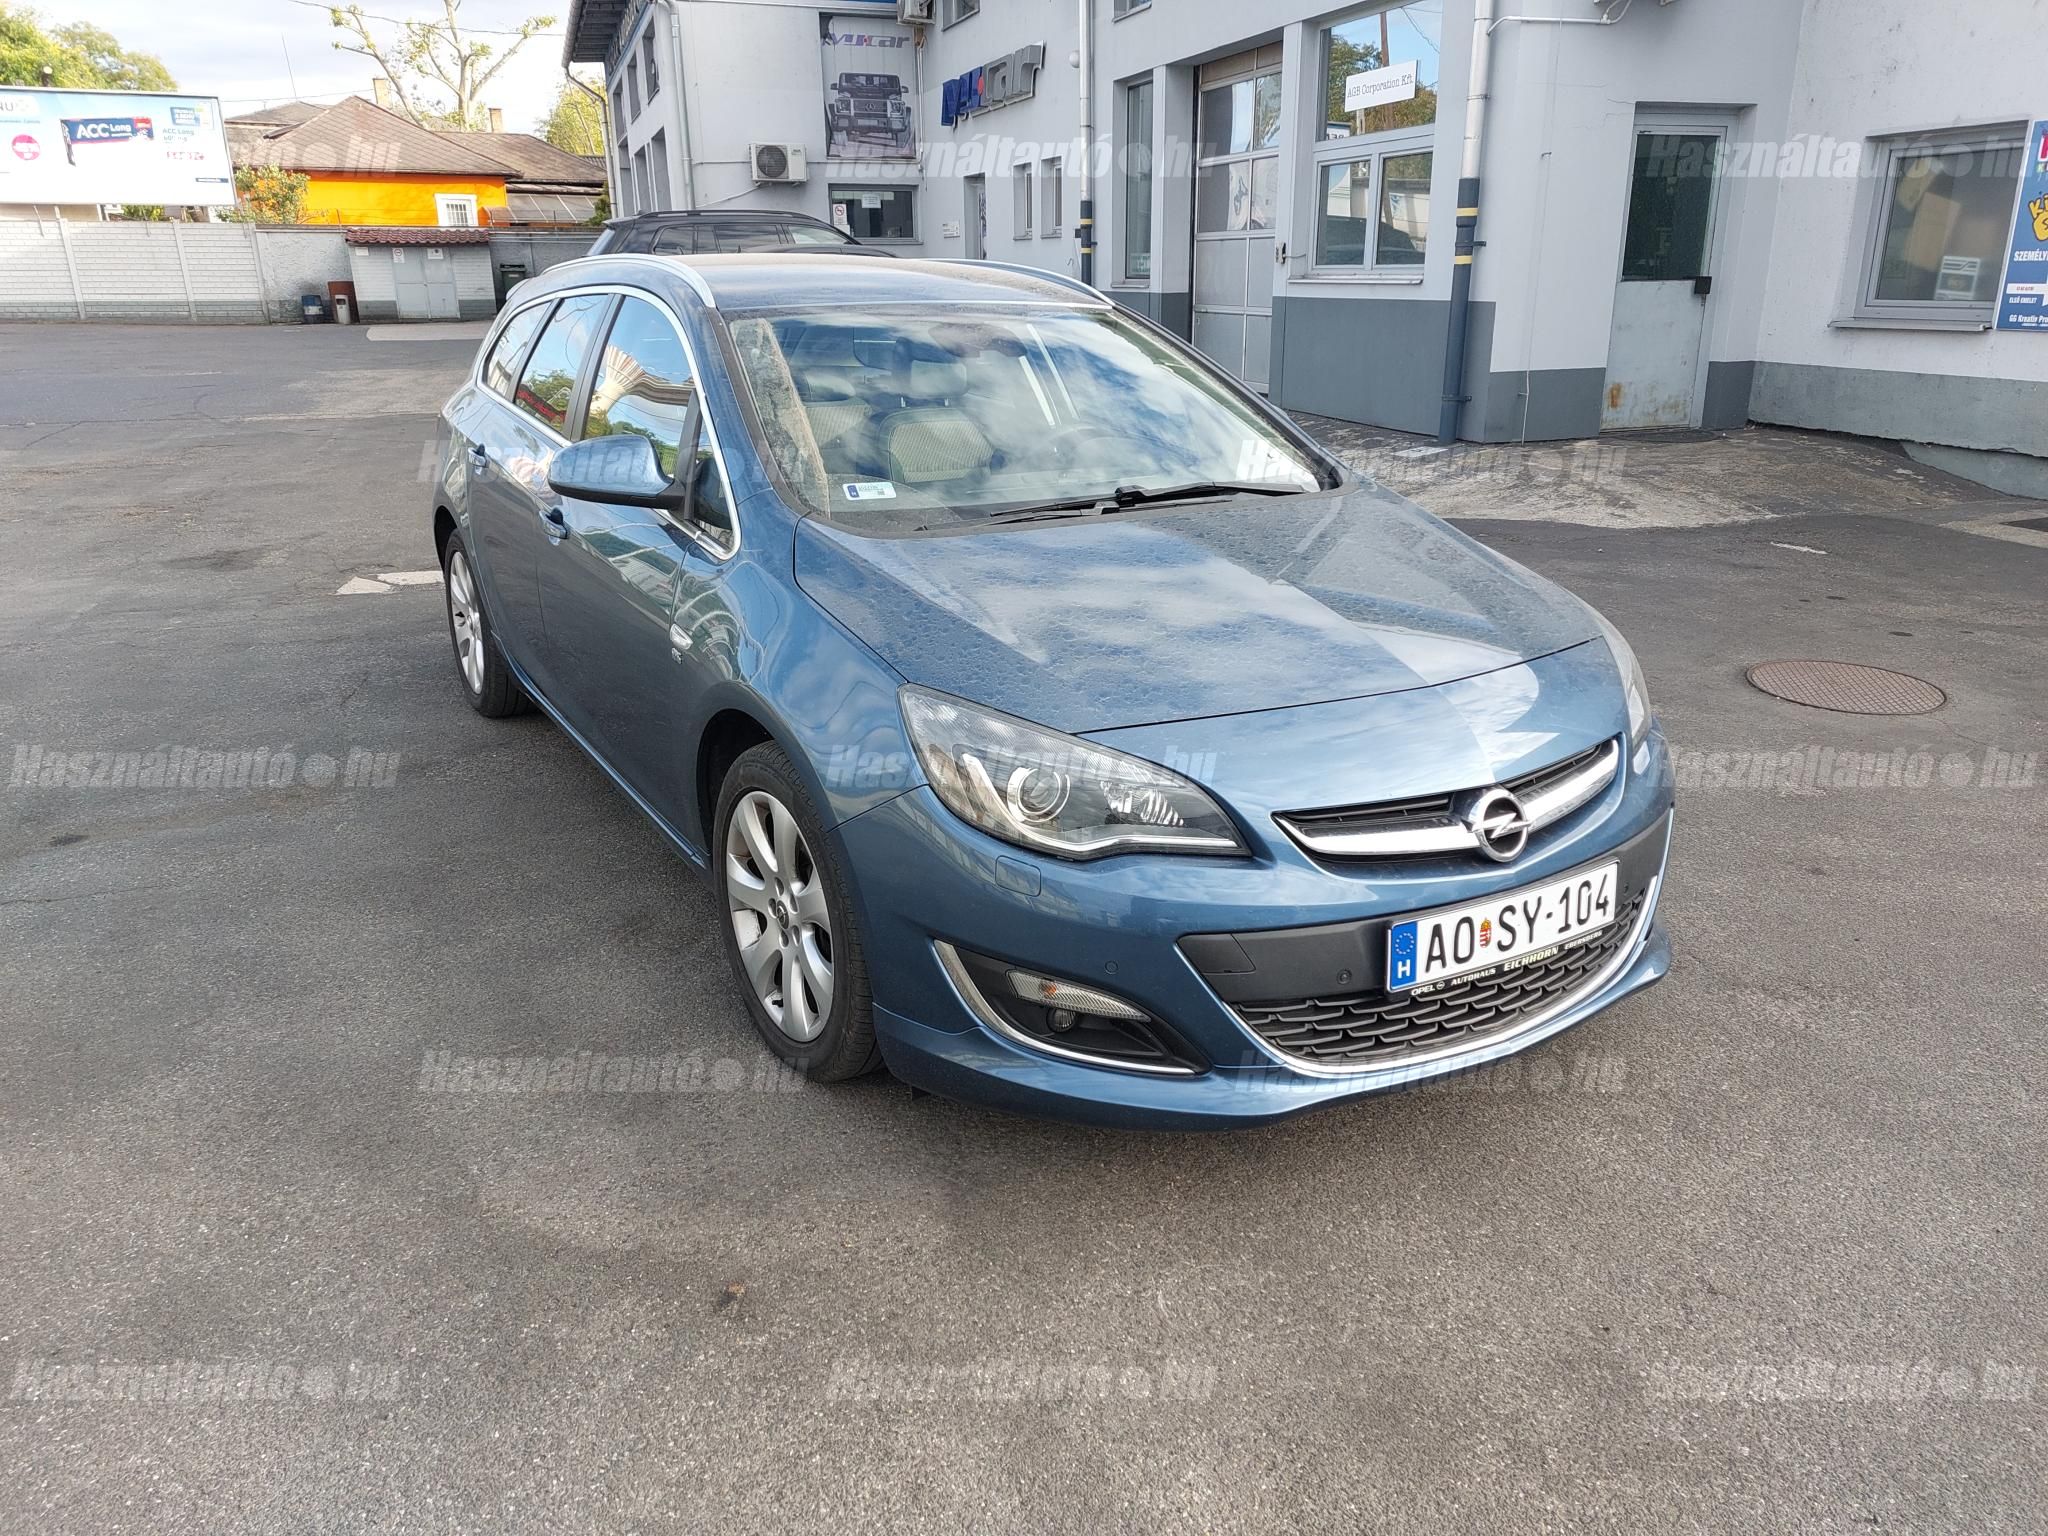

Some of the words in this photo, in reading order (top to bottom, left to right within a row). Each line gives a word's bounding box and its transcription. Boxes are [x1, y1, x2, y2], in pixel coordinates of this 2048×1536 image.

[1347, 85, 1360, 98] AGB
[1361, 79, 1400, 95] Corporation
[1401, 73, 1414, 86] Kft.
[77, 124, 110, 139] ACC
[110, 124, 132, 133] Long
[1397, 960, 1410, 979] H
[1411, 985, 1436, 996] OPEL
[1450, 967, 1496, 986] AUTOHAUS
[1503, 946, 1559, 972] EICHHORN
